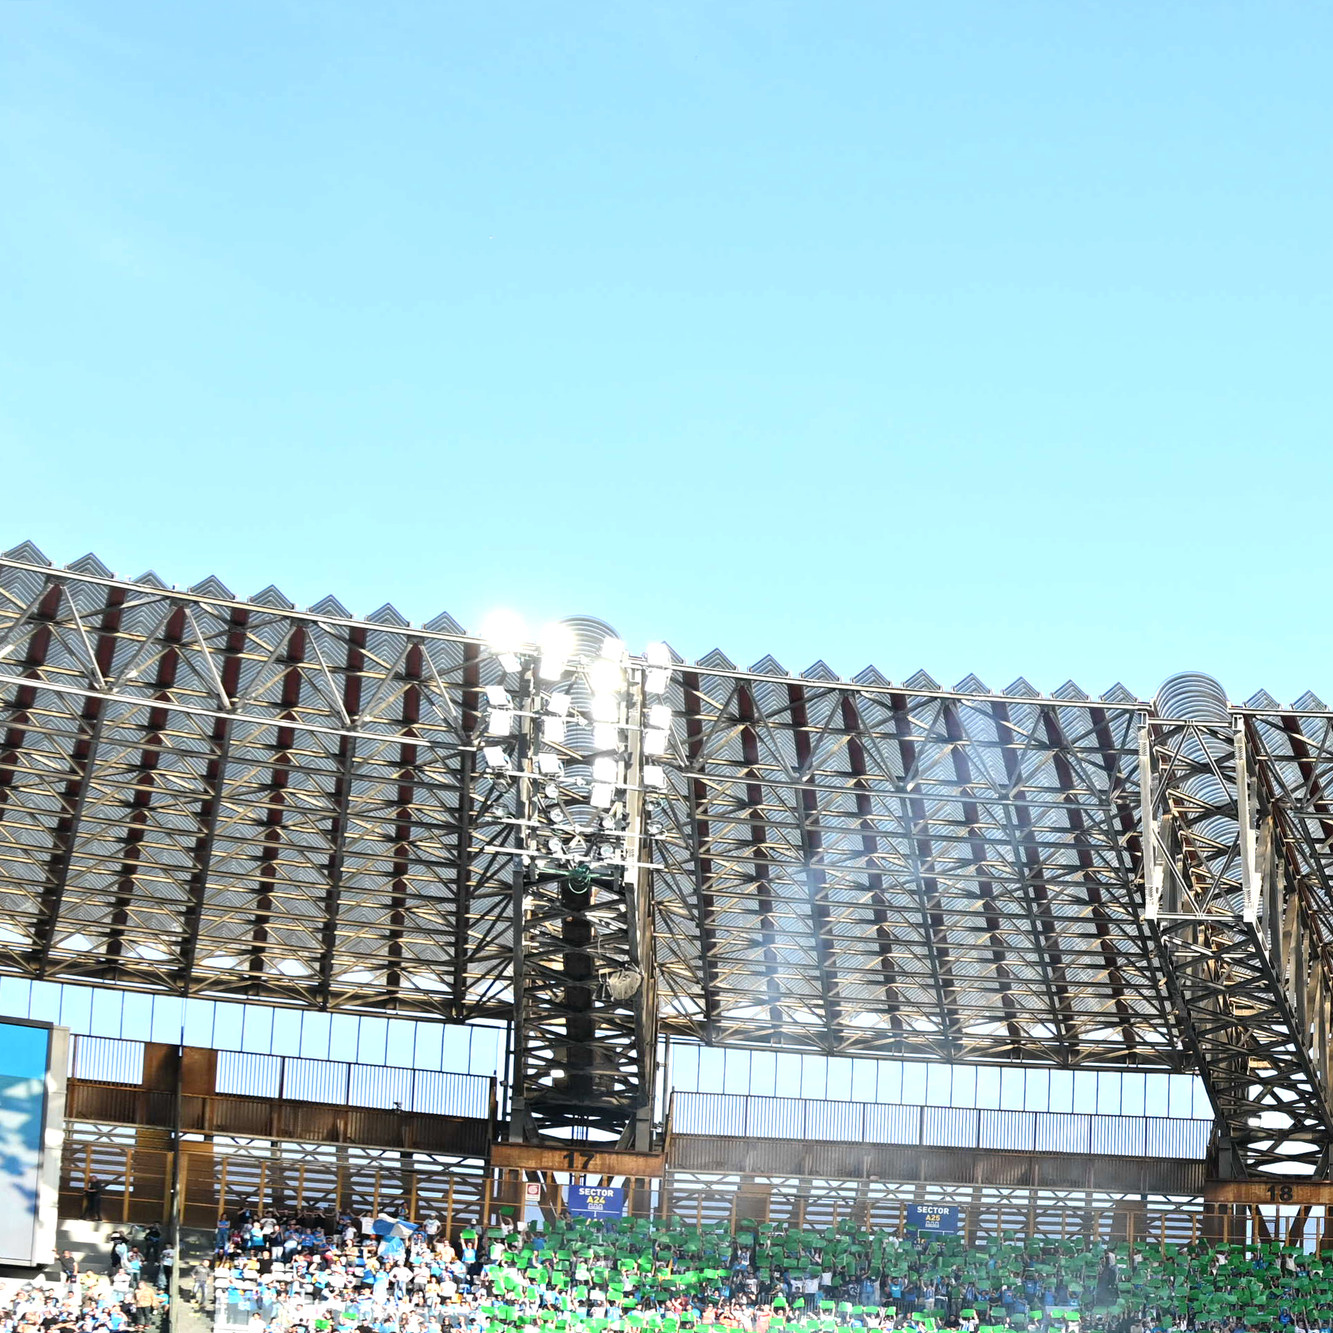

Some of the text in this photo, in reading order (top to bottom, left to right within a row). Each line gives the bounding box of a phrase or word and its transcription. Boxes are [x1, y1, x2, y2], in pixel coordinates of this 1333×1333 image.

[563, 1152, 595, 1169] 17
[578, 1187, 614, 1198] SECTOR
[1267, 1185, 1293, 1202] 18
[917, 1206, 950, 1215] SECTOR
